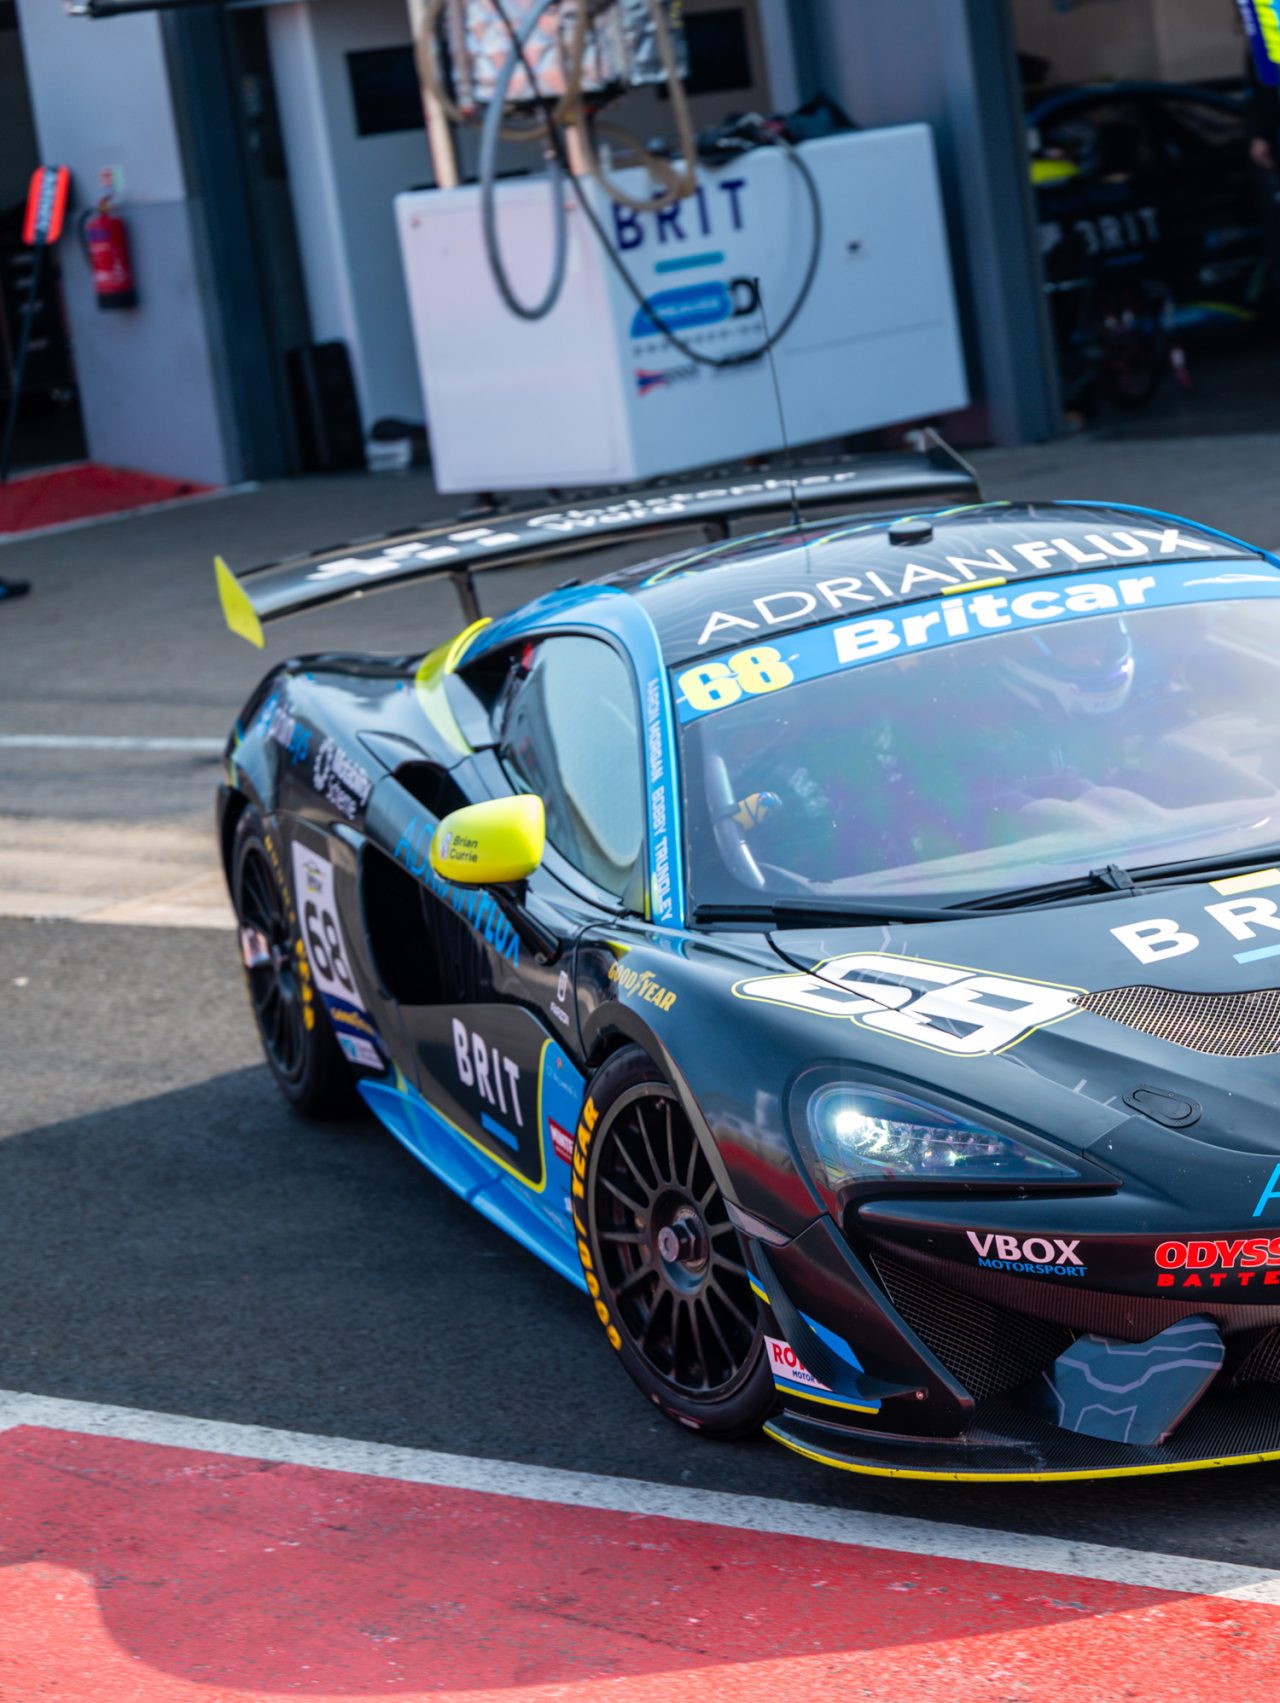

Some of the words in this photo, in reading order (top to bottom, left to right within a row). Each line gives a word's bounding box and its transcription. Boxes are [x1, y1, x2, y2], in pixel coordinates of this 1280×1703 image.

[611, 178, 746, 251] BRIT
[832, 575, 1157, 664] Britcar
[677, 645, 795, 712] 68
[651, 785, 667, 837] BOBBY
[450, 847, 478, 864] Currie
[453, 835, 479, 849] Brian
[655, 836, 674, 922] TRUNDLEY
[305, 899, 355, 994] 68
[607, 960, 677, 1013] GOODYEAR
[452, 1017, 524, 1128] BRIT
[965, 1231, 1085, 1266] VBOX
[978, 1256, 1088, 1278] MOTORSPORT
